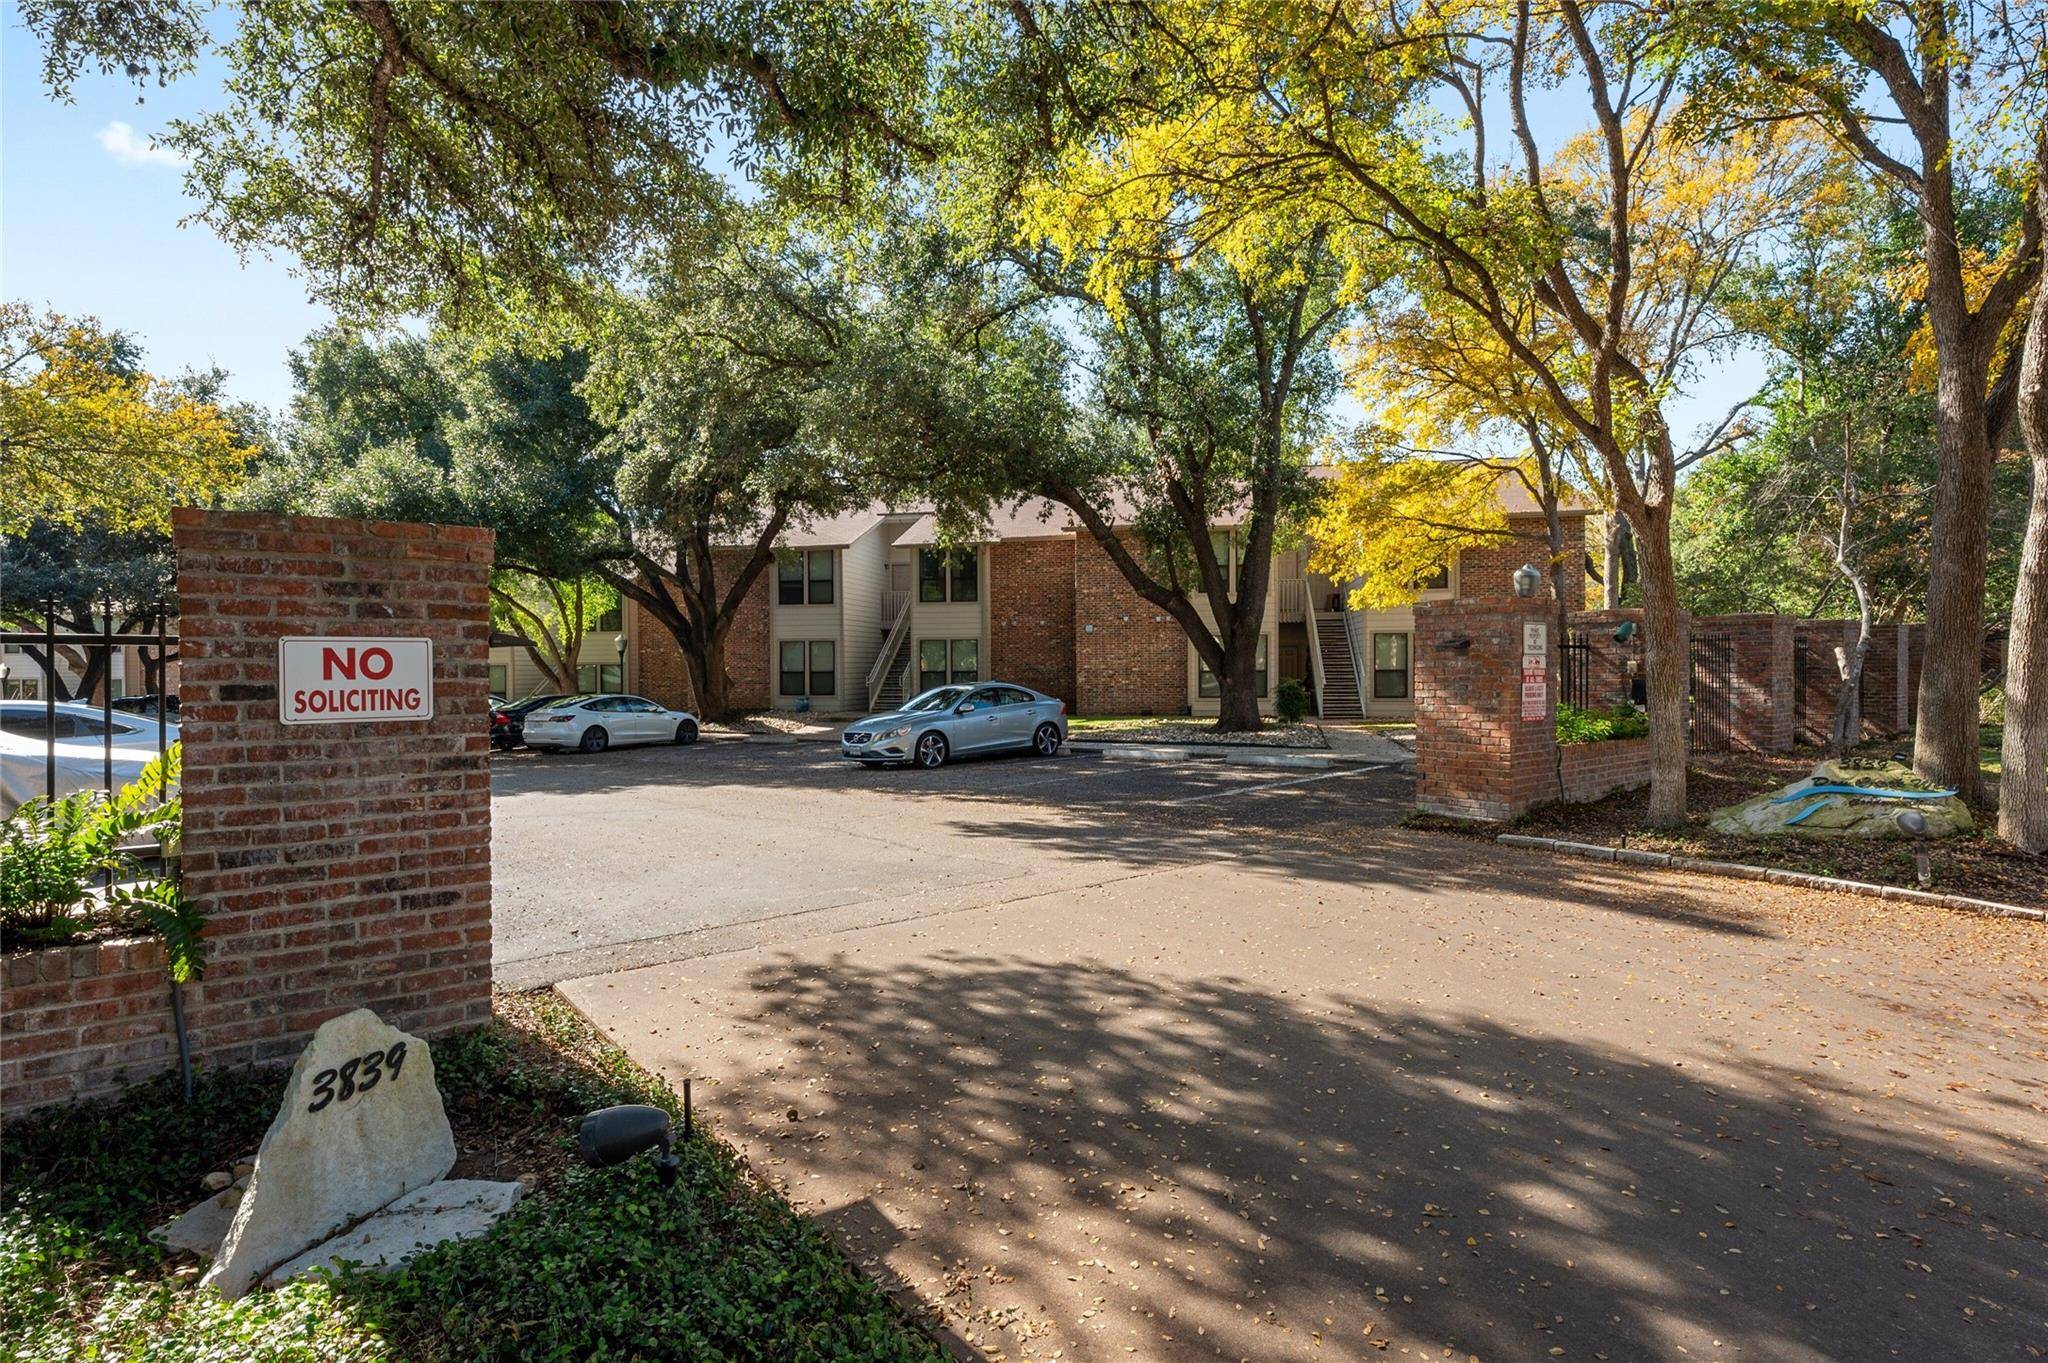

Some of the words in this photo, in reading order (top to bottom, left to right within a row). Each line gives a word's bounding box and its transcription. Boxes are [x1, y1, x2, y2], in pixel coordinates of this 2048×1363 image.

[322, 646, 394, 681] NO
[294, 688, 421, 714] SOLICITING
[1838, 757, 1889, 770] 3839
[308, 1041, 408, 1113] 3839
